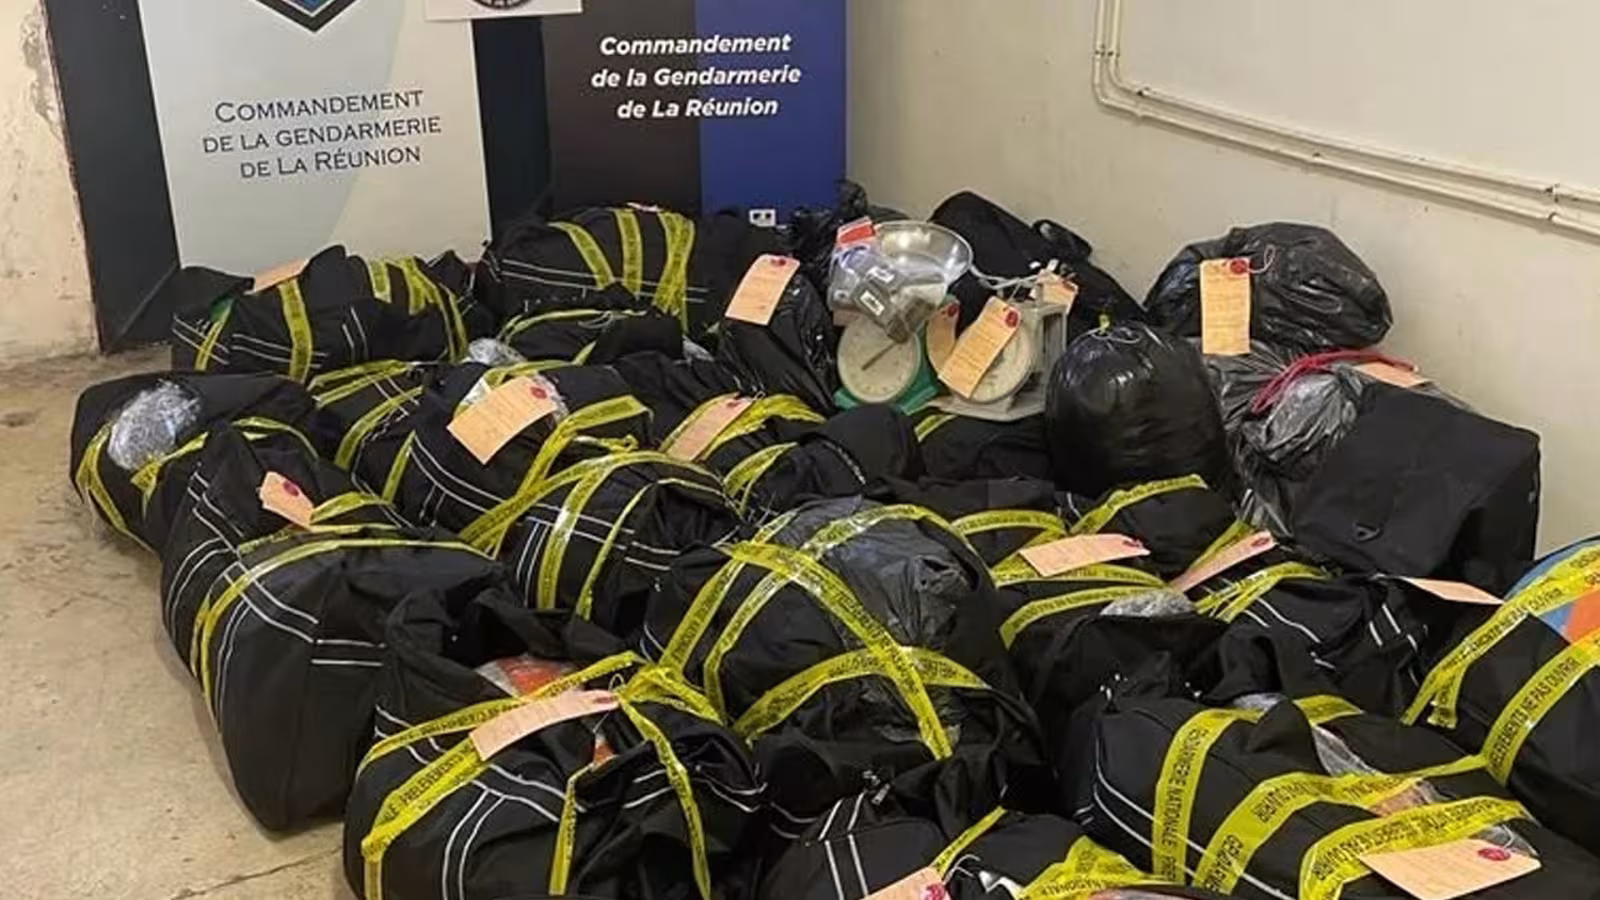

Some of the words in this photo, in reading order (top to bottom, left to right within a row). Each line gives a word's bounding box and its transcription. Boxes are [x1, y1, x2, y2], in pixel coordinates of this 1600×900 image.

[599, 34, 792, 55] Commandement
[591, 69, 621, 87] de
[626, 68, 648, 87] la
[653, 65, 802, 86] Gendarmerie
[214, 89, 424, 123] COMMANDEMENT
[616, 101, 647, 119] de
[651, 100, 680, 118] La
[684, 97, 779, 117] Réunion
[202, 136, 235, 153] DE
[240, 134, 270, 151] LA
[275, 116, 442, 147] GENDARMERIE
[240, 161, 272, 179] DE
[314, 146, 422, 172] RÉUNION
